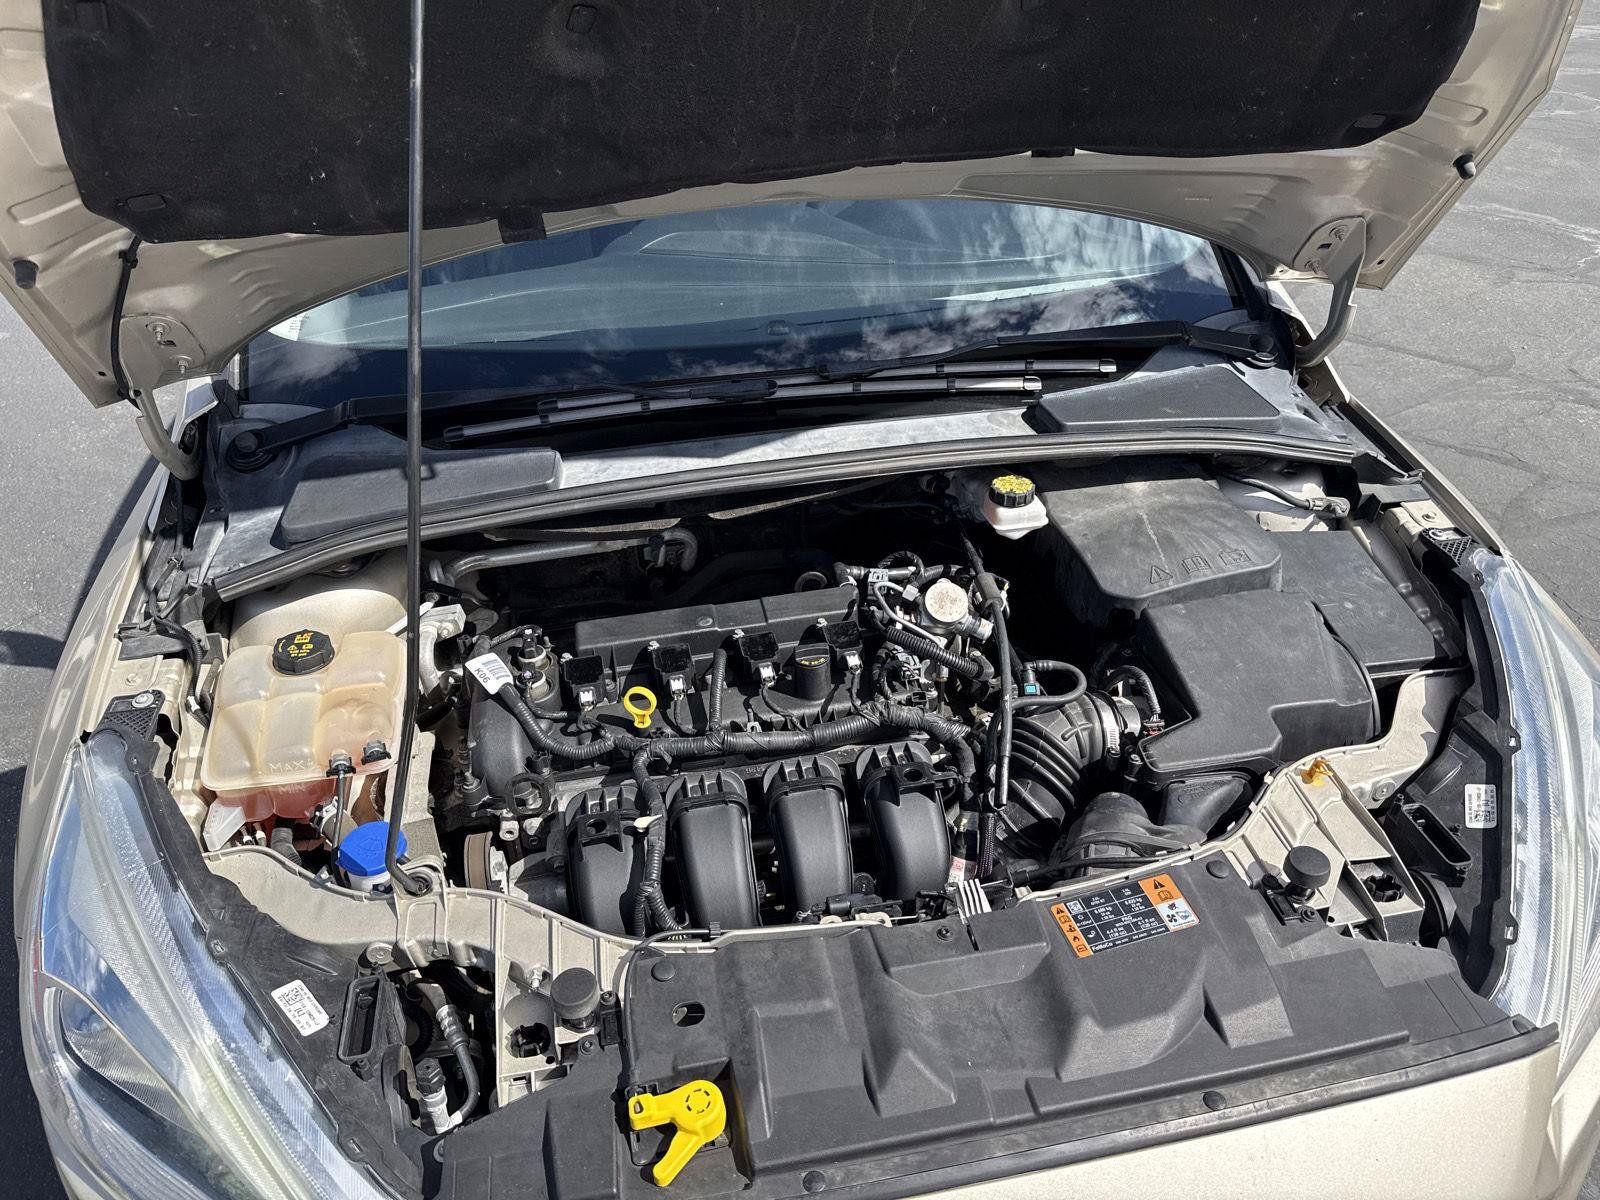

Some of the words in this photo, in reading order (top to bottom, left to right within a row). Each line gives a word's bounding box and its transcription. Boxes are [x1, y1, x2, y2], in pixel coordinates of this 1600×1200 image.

[474, 667, 491, 684] K06
[269, 760, 305, 775] MAX
[279, 783, 306, 794] MIN
